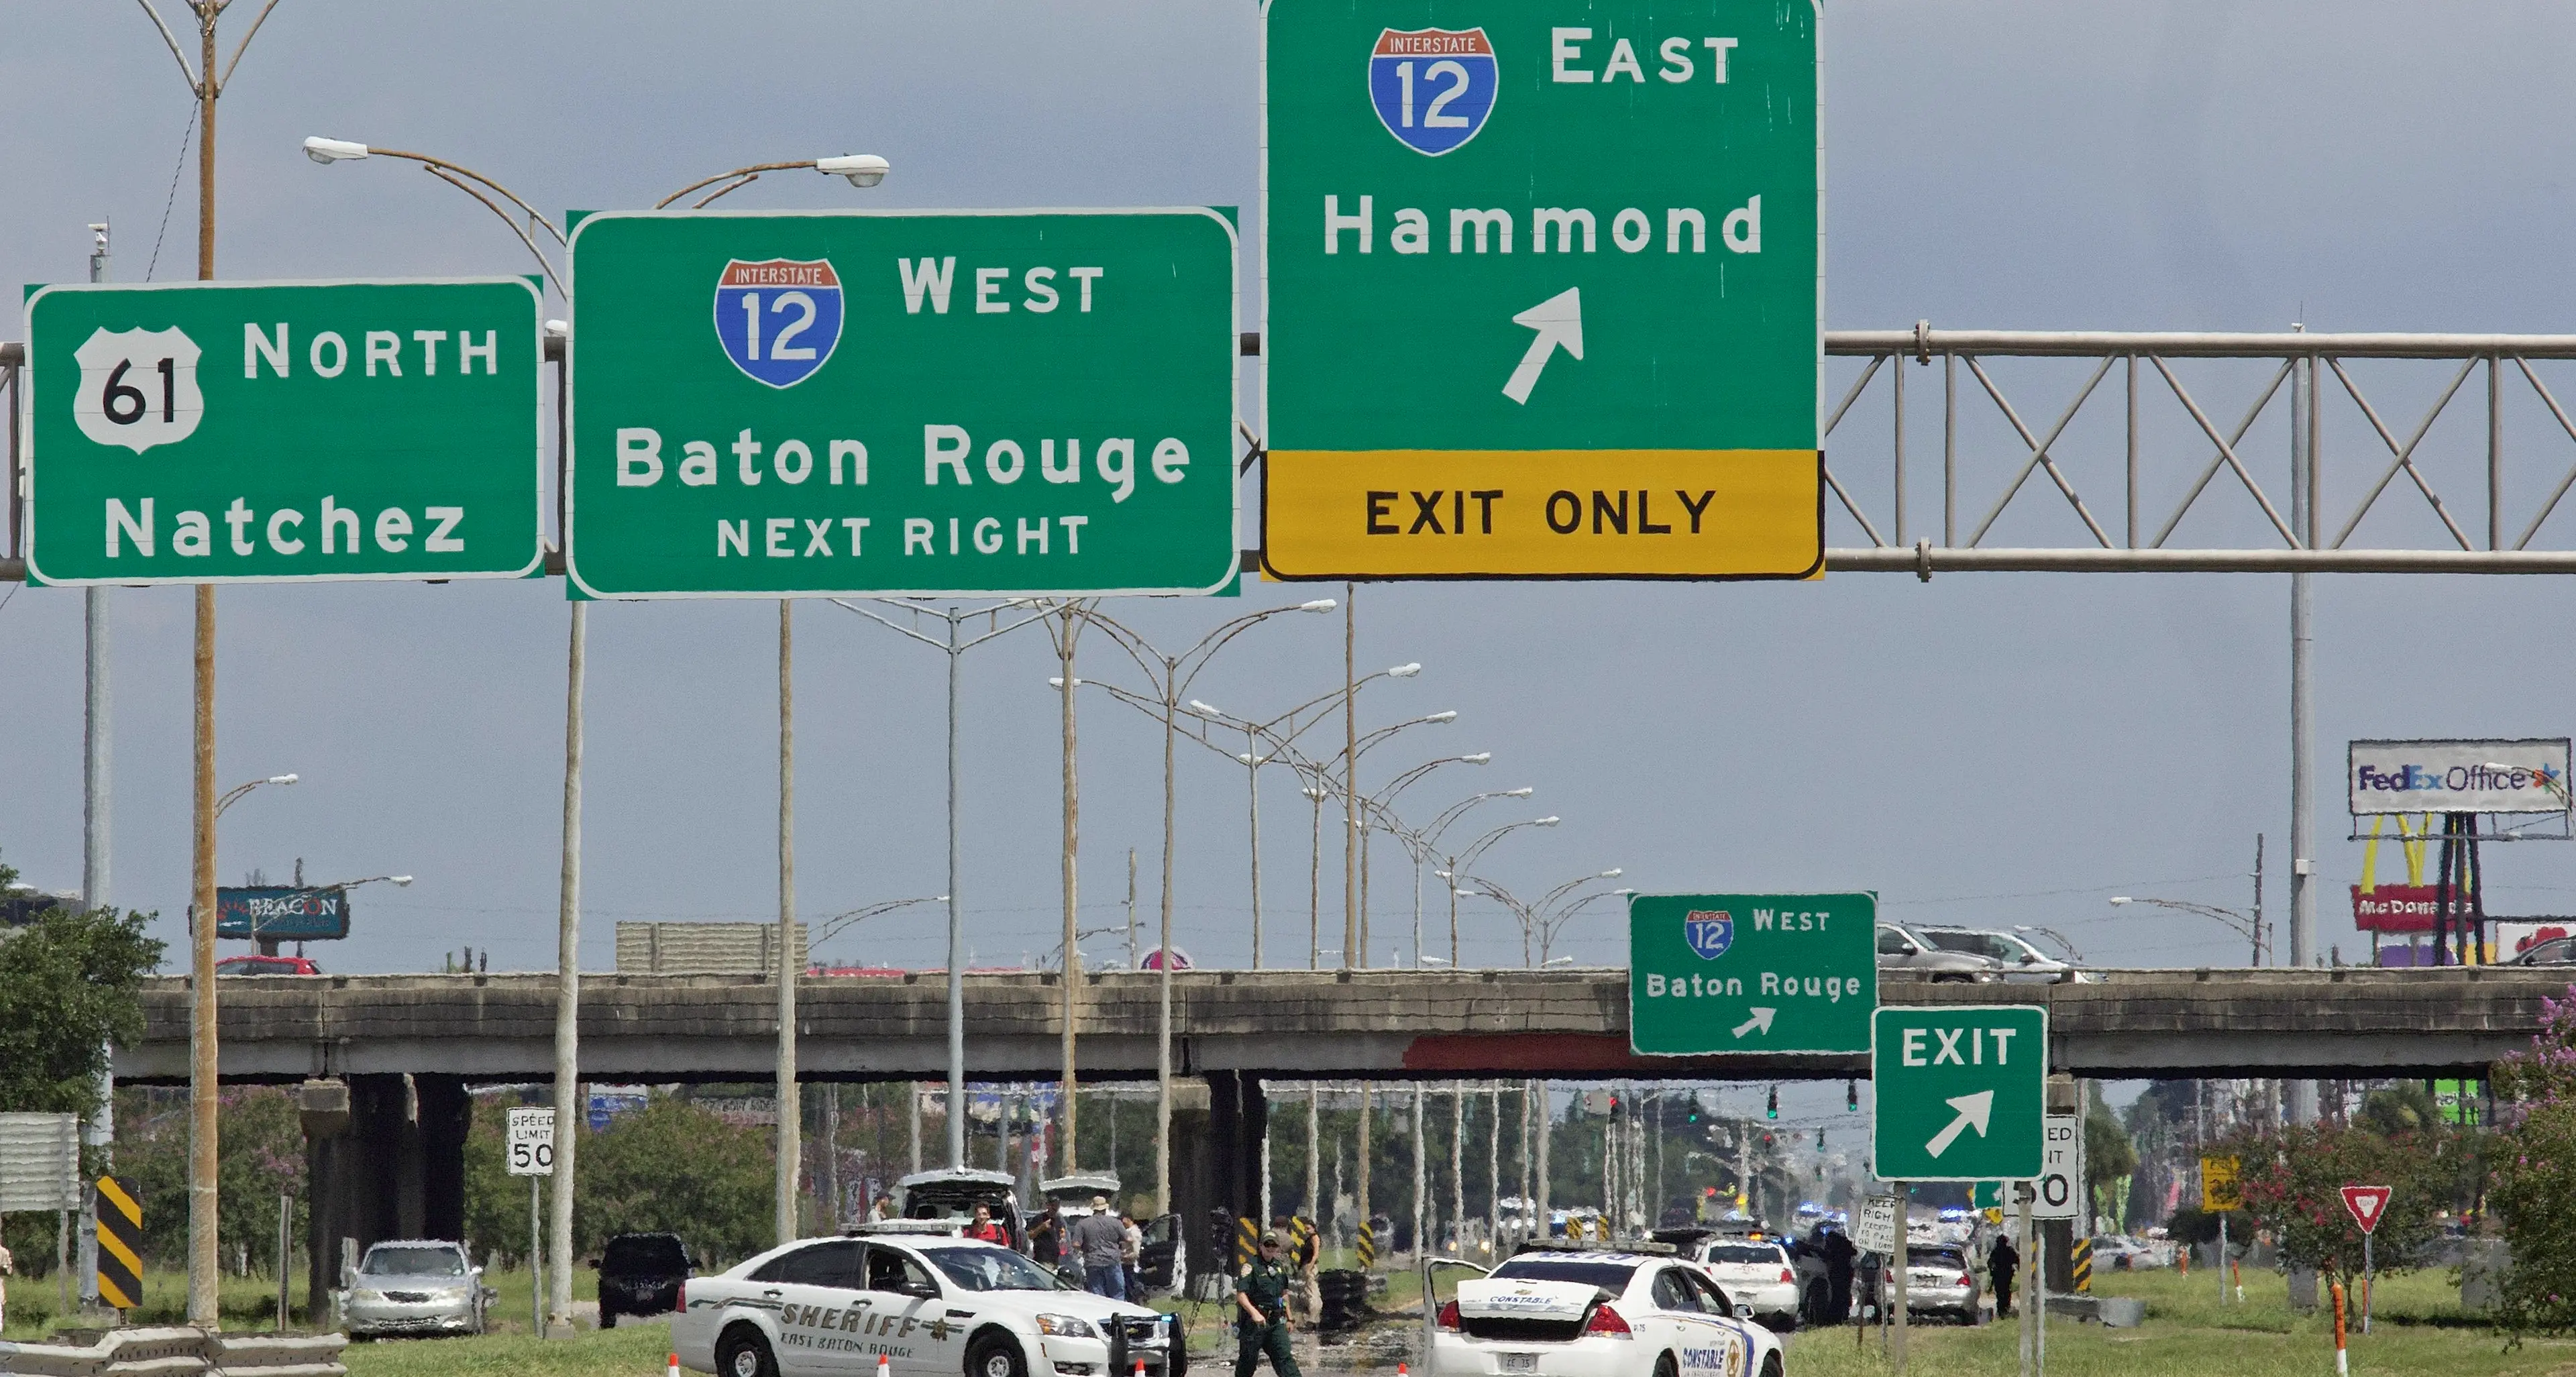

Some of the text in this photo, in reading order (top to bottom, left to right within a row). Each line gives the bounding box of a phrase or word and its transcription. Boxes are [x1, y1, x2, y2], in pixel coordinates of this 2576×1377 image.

[1390, 37, 1476, 53] INTERSTATE
[1552, 27, 1738, 84] EAST
[1396, 60, 1470, 129] 12
[1324, 194, 1761, 254] Hammond
[735, 267, 822, 286] INTERSTATE
[898, 256, 1104, 314] WEST
[741, 291, 816, 361] 12
[244, 323, 497, 378] NORTH
[103, 357, 174, 425] 61
[616, 424, 1191, 504] Baton Rouge
[105, 494, 465, 558] Natchez
[1366, 490, 1717, 535] EXIT ONLY
[717, 515, 1089, 558] NEXT RIGHT
[2359, 765, 2443, 791] FedEx
[1695, 922, 1725, 949] 12
[1753, 908, 1829, 932] WEST
[1647, 971, 1860, 1003] Baton Rouge
[1902, 1028, 2017, 1066] EXIT
[512, 1115, 553, 1126] SPEED
[516, 1130, 550, 1140] LIMIT
[515, 1144, 552, 1168] 50
[1490, 1296, 1554, 1304] CONSTABLE
[781, 1303, 920, 1338] SHERIFF
[781, 1332, 914, 1358] EAST BATON ROUGE
[1682, 1347, 1725, 1369] CONSTABLE
